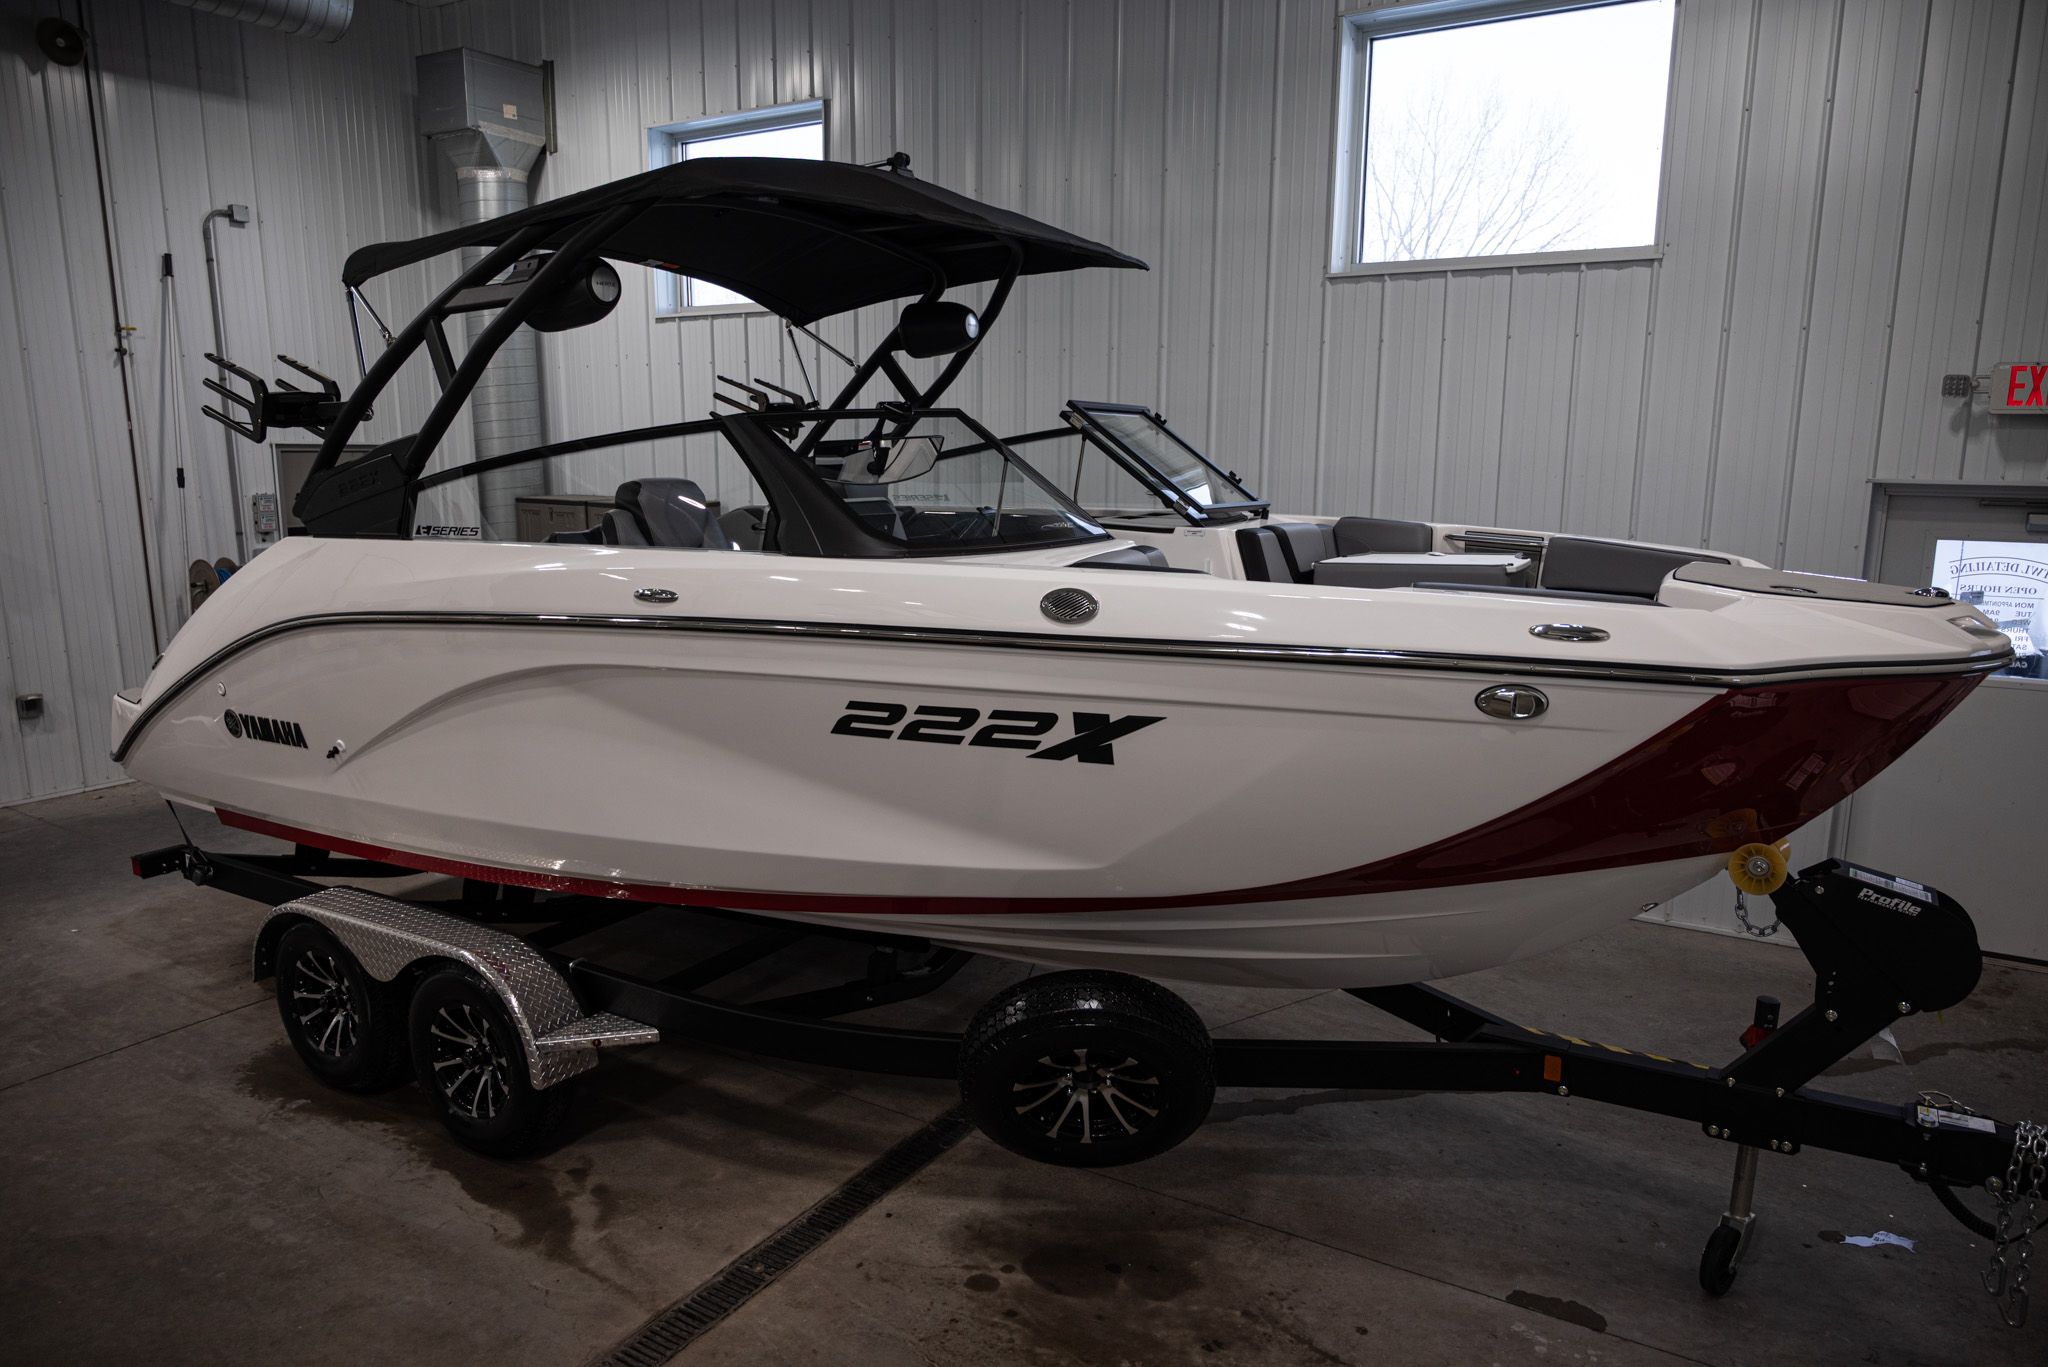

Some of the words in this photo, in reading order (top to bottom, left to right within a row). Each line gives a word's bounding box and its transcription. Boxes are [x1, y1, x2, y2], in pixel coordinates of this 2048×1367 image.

[2007, 366, 2048, 406] EX
[431, 526, 480, 537] SERIES
[238, 713, 309, 749] YAMAHA
[830, 700, 1168, 765] 222X
[1858, 887, 1922, 913] Profile
